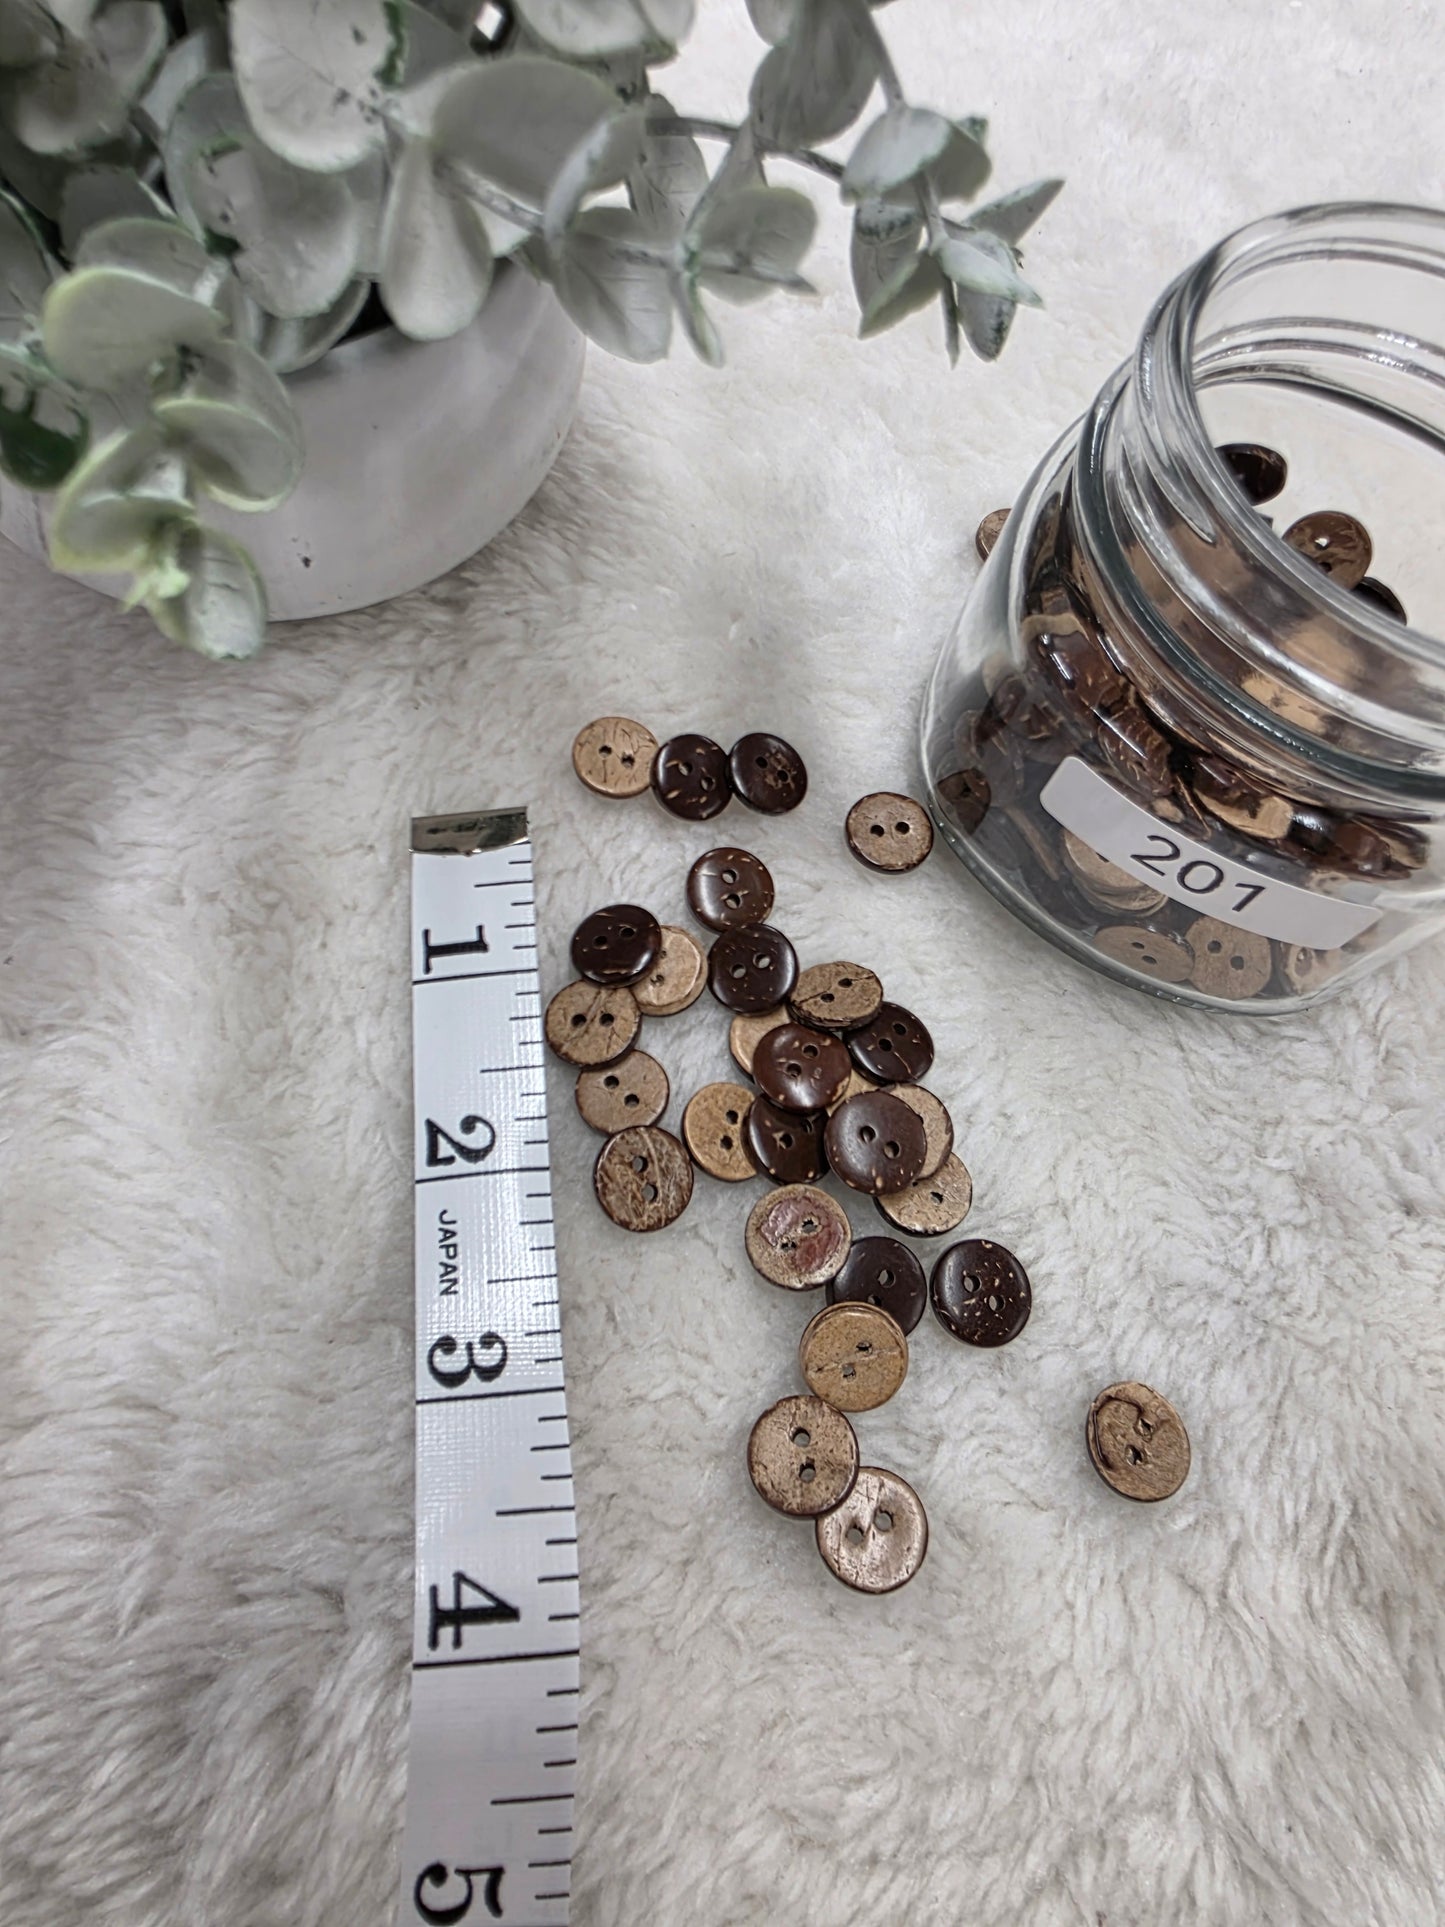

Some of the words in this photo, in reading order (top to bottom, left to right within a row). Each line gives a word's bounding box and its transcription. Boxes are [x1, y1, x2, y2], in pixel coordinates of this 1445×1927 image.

[1130, 834, 1268, 913] 201
[421, 924, 490, 976] 1
[424, 1114, 497, 1168] 2
[438, 1209, 459, 1297] JAPAN
[427, 1331, 508, 1389] 3
[427, 1571, 521, 1651] 4
[413, 1860, 506, 1927] 5
